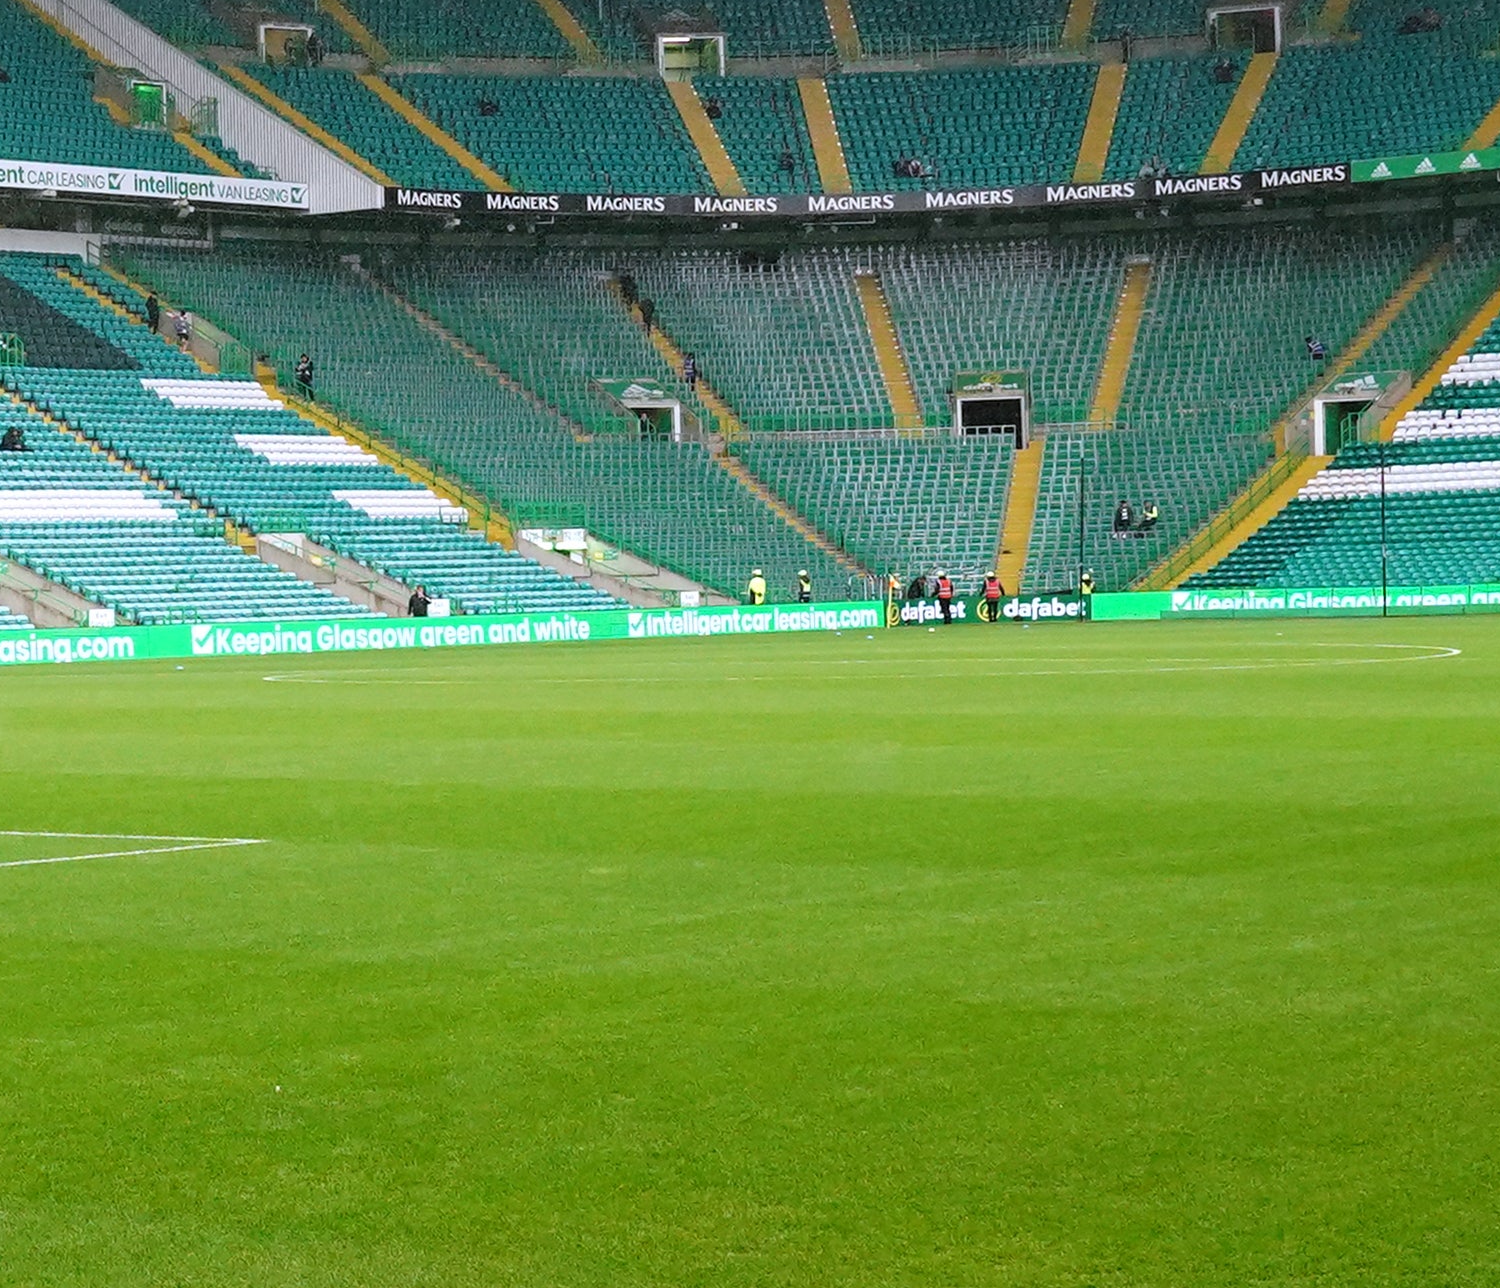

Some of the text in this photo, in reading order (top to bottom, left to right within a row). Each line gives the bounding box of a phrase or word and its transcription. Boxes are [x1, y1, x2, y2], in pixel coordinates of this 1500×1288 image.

[27, 170, 55, 186] CAR
[55, 172, 106, 190] LEASING
[1155, 174, 1242, 195] MAGNERS
[1261, 166, 1346, 187] MAGNERS
[134, 175, 290, 204] intelligent VAN LEASING
[397, 189, 462, 209] MAGNERS
[925, 188, 1015, 209] MAGNERS
[1046, 182, 1135, 203] MAGNERS
[486, 194, 559, 211] MAGNERS
[587, 195, 665, 212] MAGNERS
[694, 196, 778, 213] MAGNERS
[808, 194, 895, 212] MAGNERS
[774, 602, 878, 630] leasing.com
[215, 614, 590, 656] Keeping Glasgow green and white
